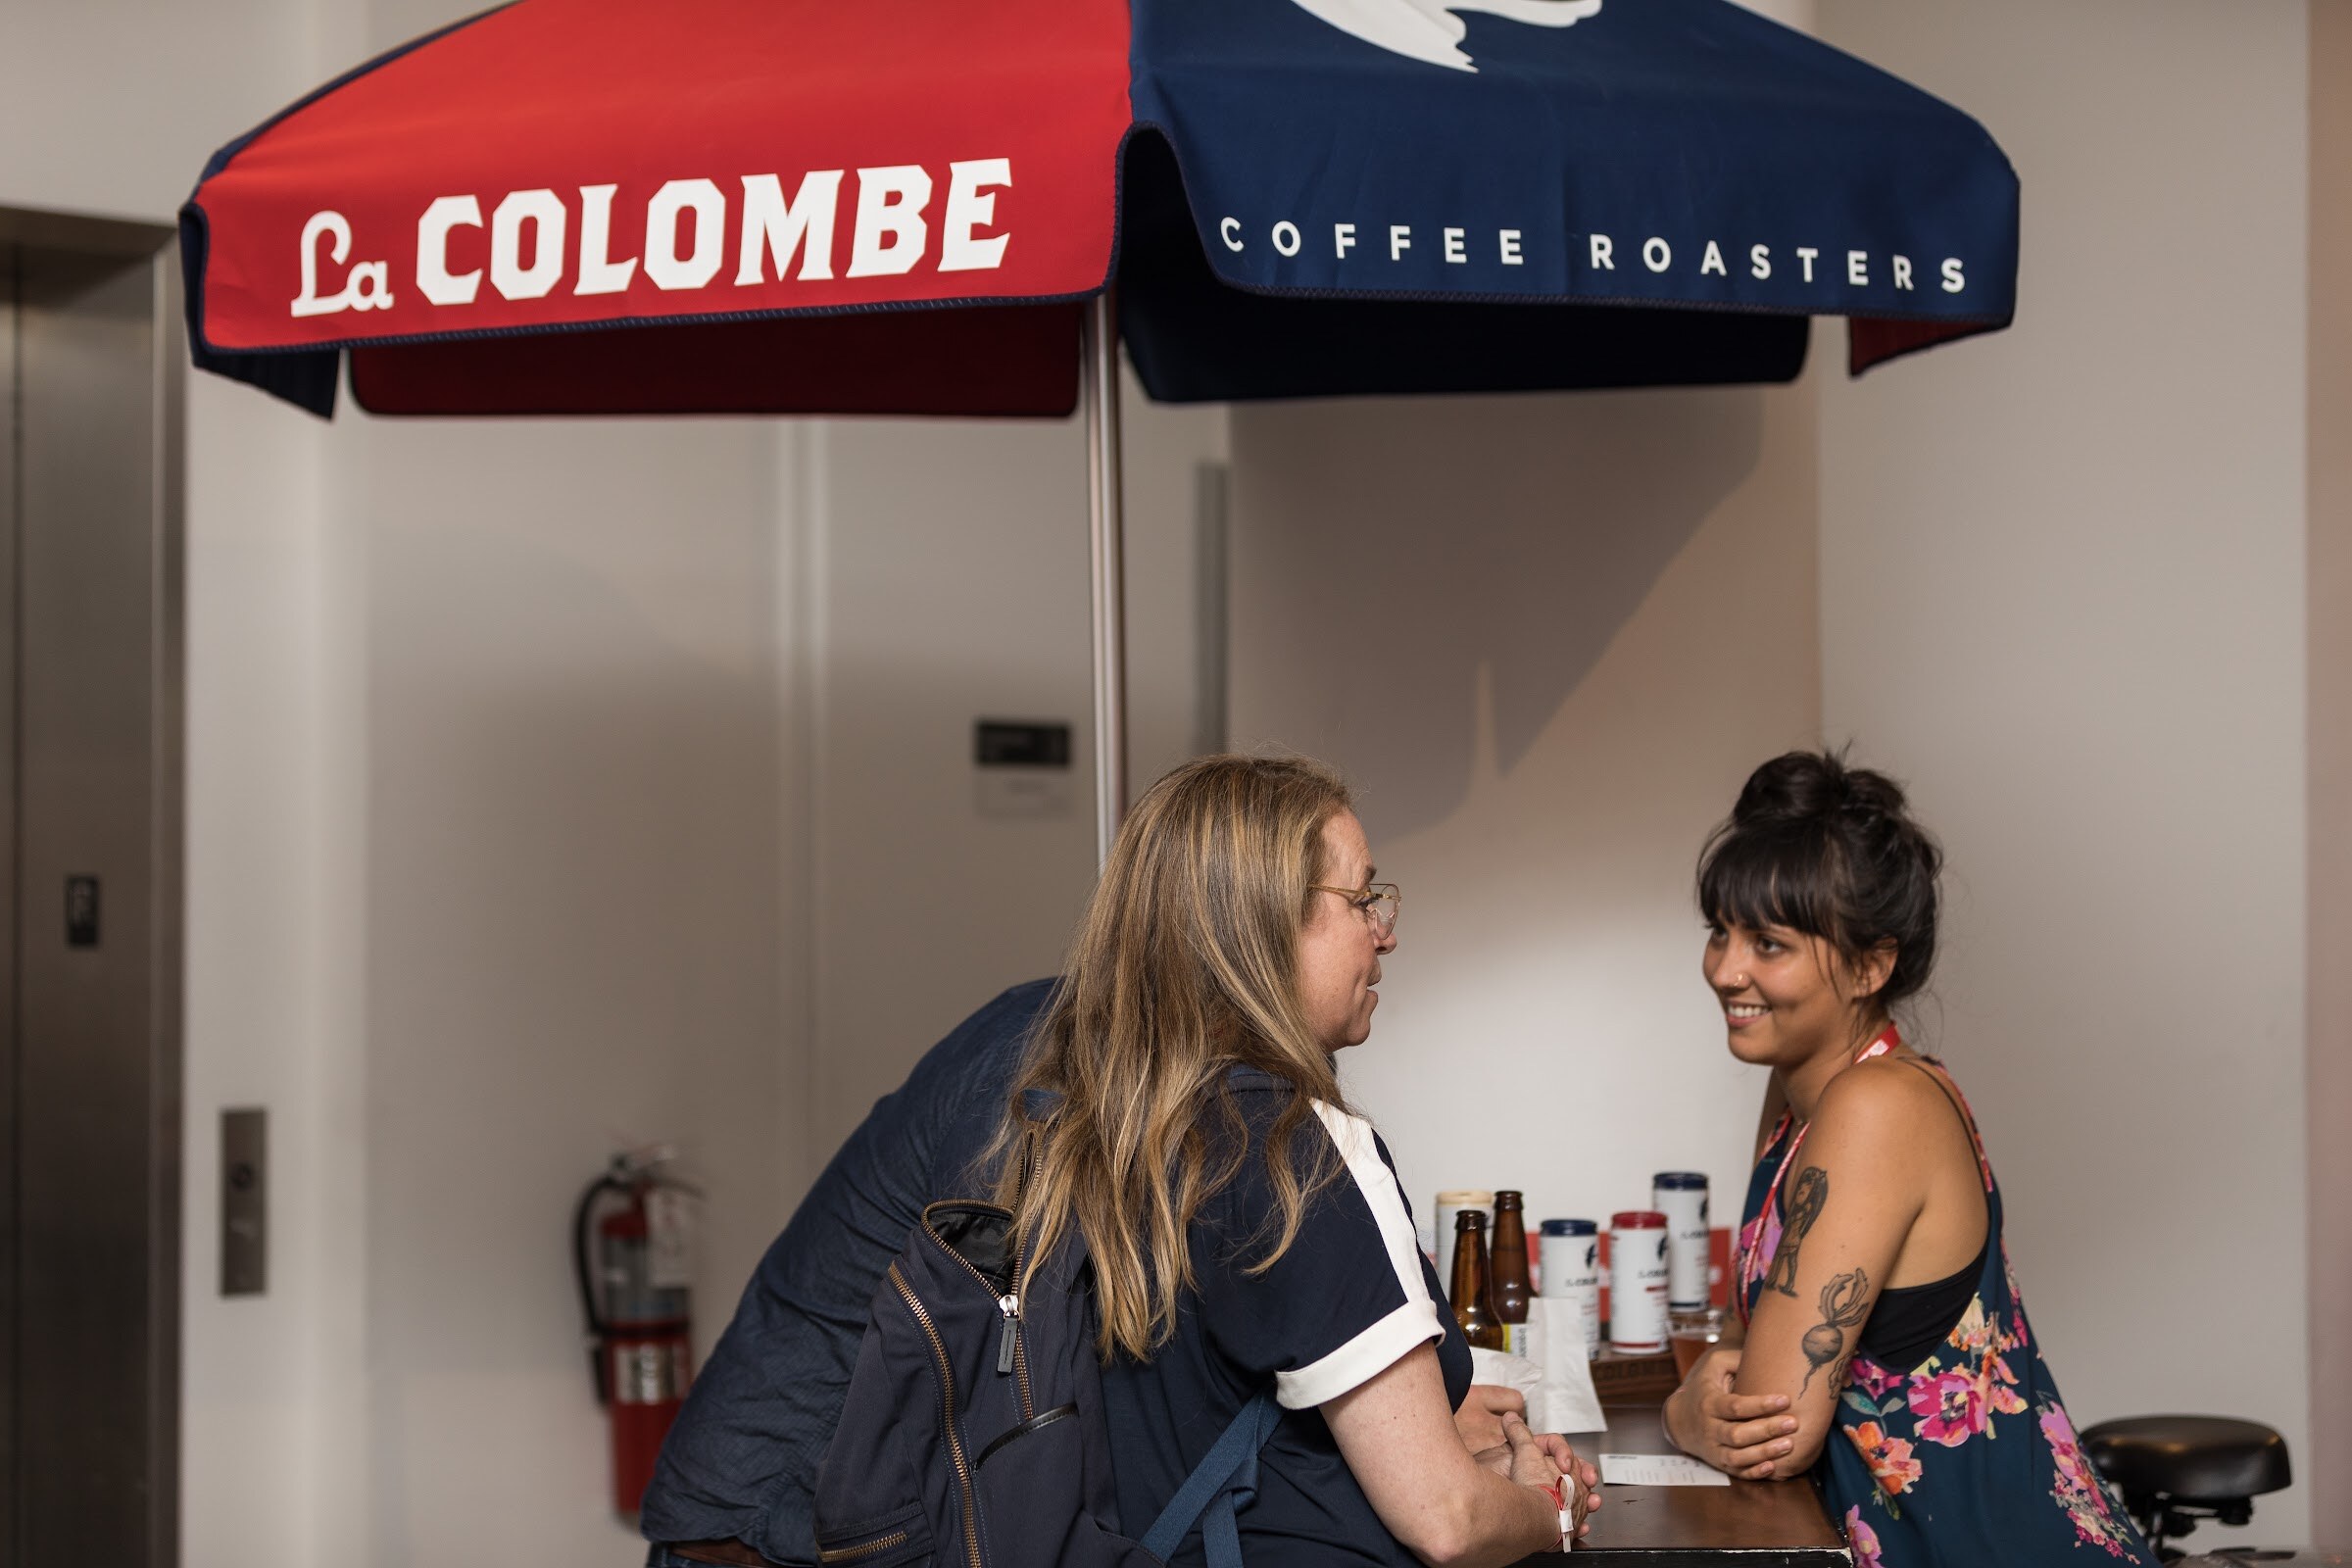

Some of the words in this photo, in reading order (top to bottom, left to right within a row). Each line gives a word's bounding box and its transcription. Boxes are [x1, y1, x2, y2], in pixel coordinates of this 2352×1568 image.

[290, 211, 394, 318] La
[416, 157, 1012, 306] COLOMBE
[1220, 217, 1524, 265] COFFEE
[1590, 233, 1966, 293] ROASTERS
